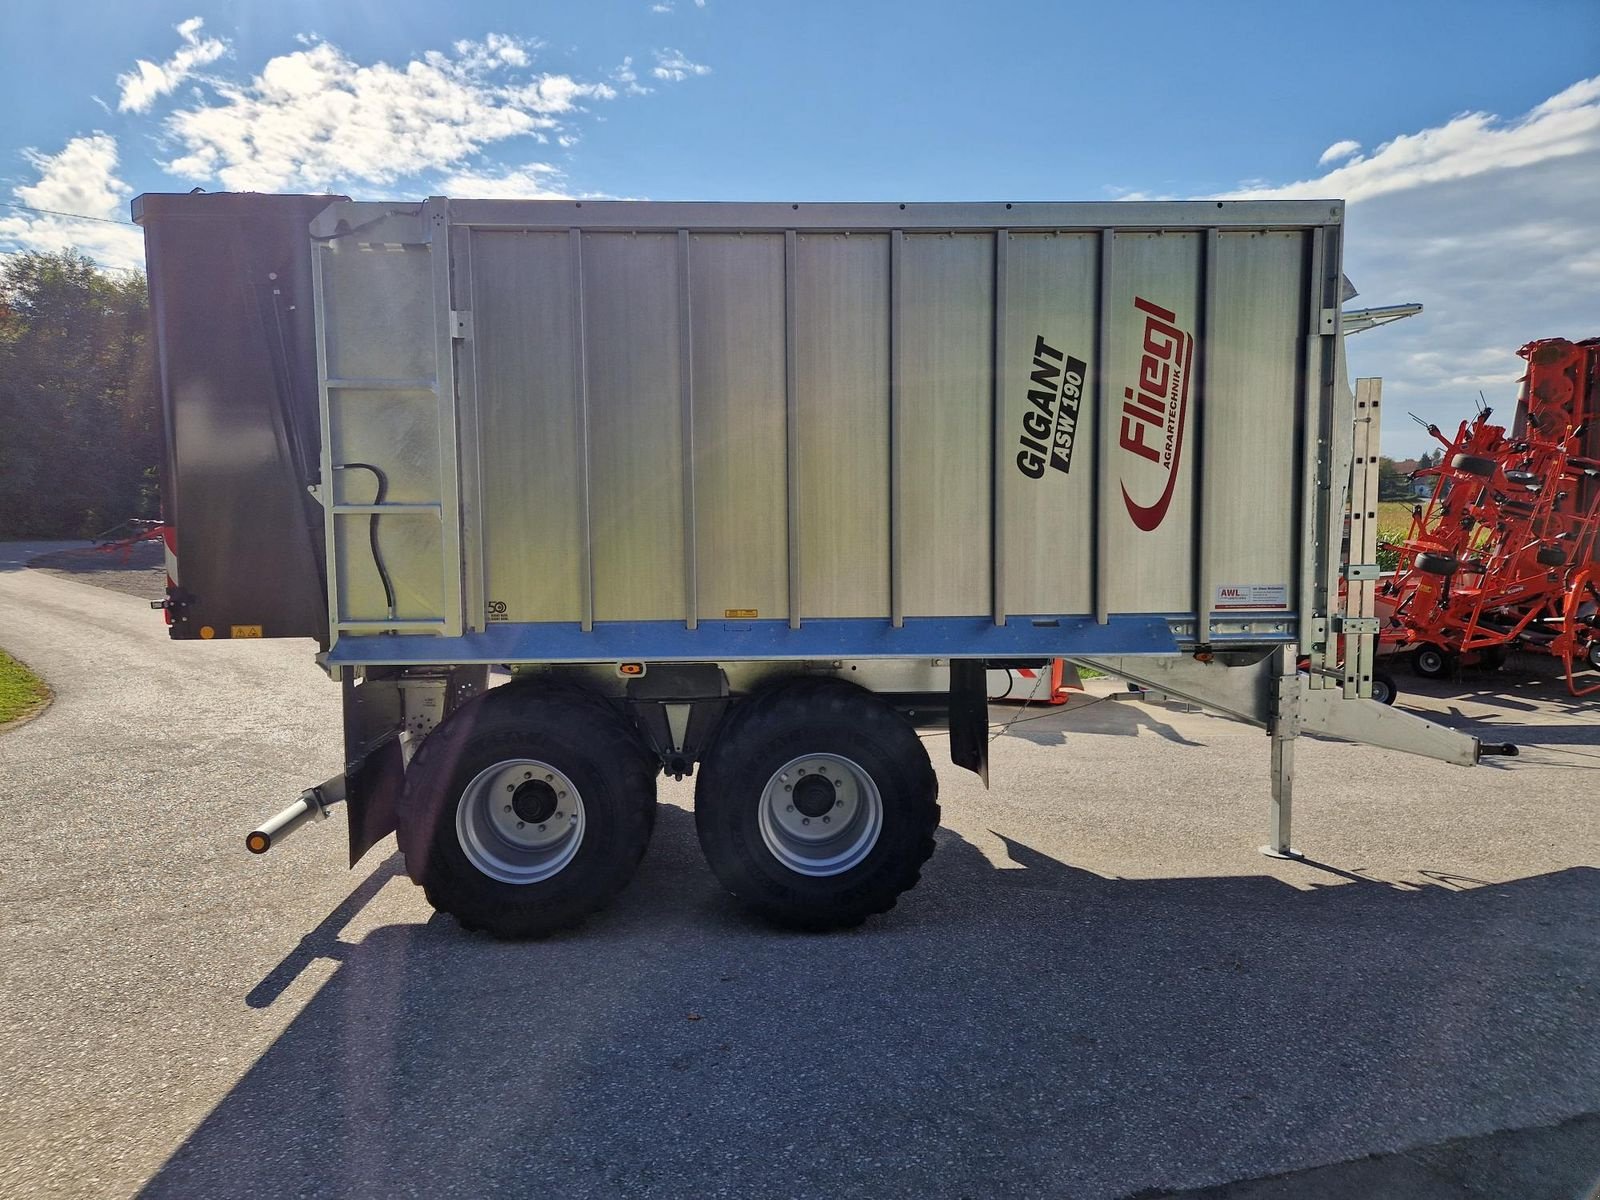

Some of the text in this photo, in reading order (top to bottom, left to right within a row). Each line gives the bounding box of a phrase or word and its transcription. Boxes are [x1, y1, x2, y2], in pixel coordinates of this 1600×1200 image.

[1016, 334, 1064, 480] GIGANT
[1055, 370, 1082, 463] ASW 190
[1119, 296, 1185, 463] Fliegl
[1163, 368, 1181, 470] AGRARTECHNIK
[1221, 589, 1240, 597] AWL
